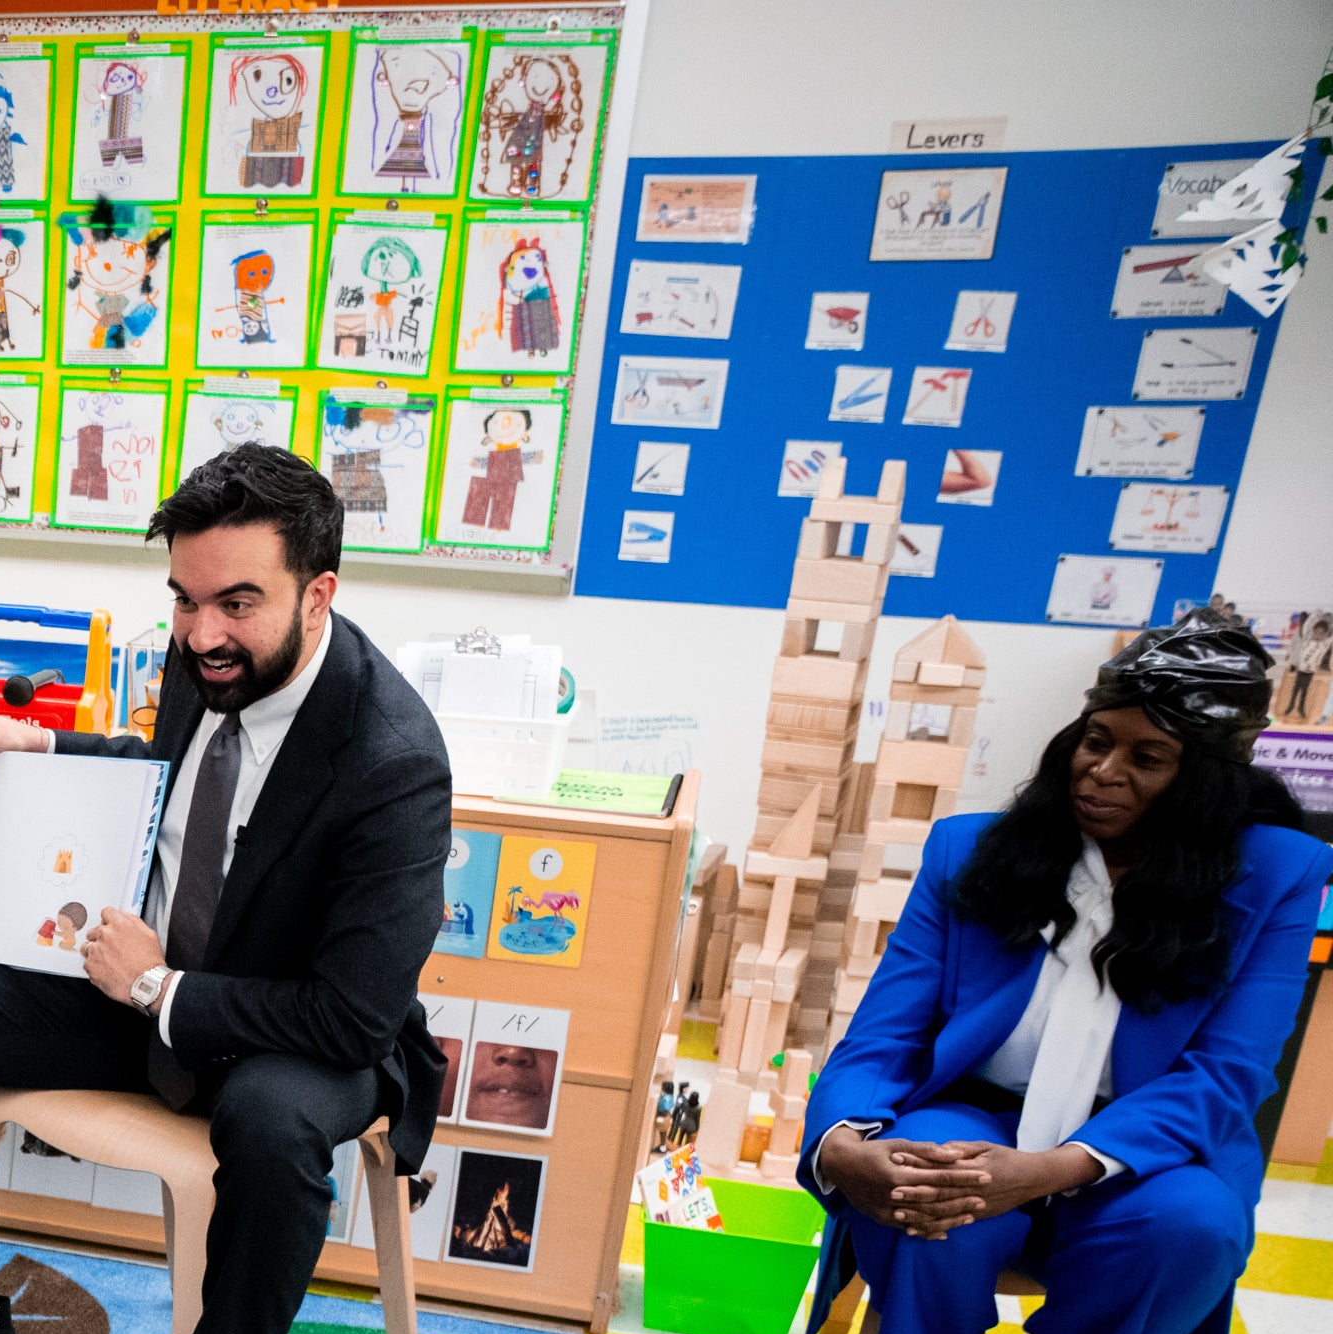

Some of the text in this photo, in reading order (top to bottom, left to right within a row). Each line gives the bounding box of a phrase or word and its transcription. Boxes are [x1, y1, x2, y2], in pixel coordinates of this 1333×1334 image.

[906, 124, 985, 150] Levers
[380, 348, 427, 368] TOMMY
[1275, 746, 1288, 760] &
[448, 848, 458, 858] o
[540, 854, 553, 873] f
[502, 1013, 540, 1033] /f/
